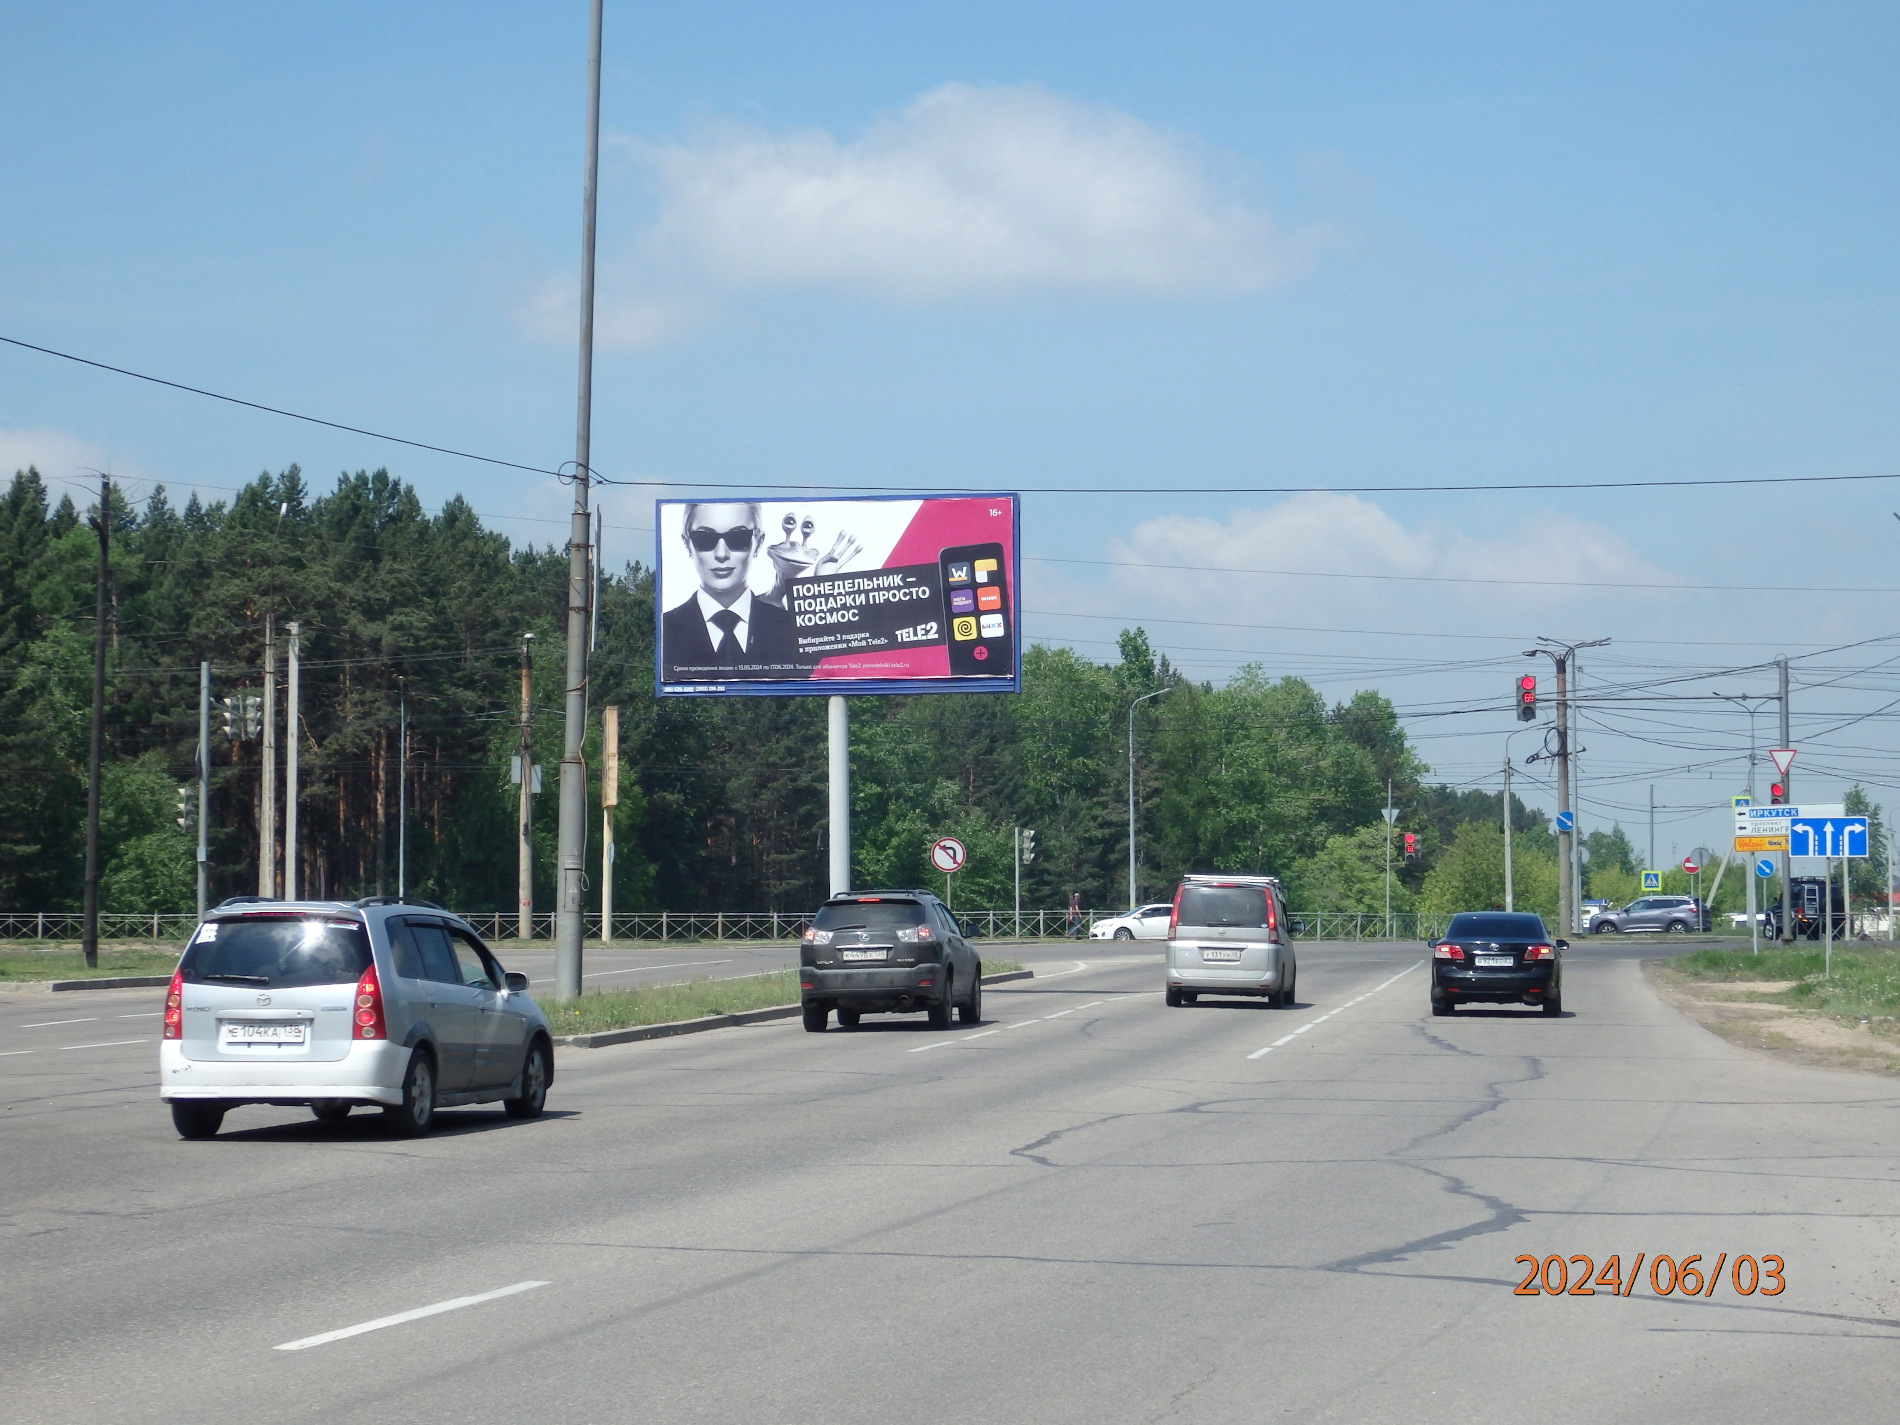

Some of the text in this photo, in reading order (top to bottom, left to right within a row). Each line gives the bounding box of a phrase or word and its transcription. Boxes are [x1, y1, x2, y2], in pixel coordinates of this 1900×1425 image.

[989, 508, 1002, 517] 16+
[792, 573, 904, 598] ПОНЕДЕЛЬНИК
[794, 586, 930, 612] ПОДАРКИ ПРОСТО
[795, 608, 860, 627] КОСМОС
[798, 635, 835, 645] Выбирайте
[842, 632, 870, 641] подарка
[895, 621, 939, 643] TELE2
[804, 643, 847, 653] приложении
[1750, 808, 1797, 818] ИРКУТСК
[231, 1024, 300, 1038] Е104КА 138
